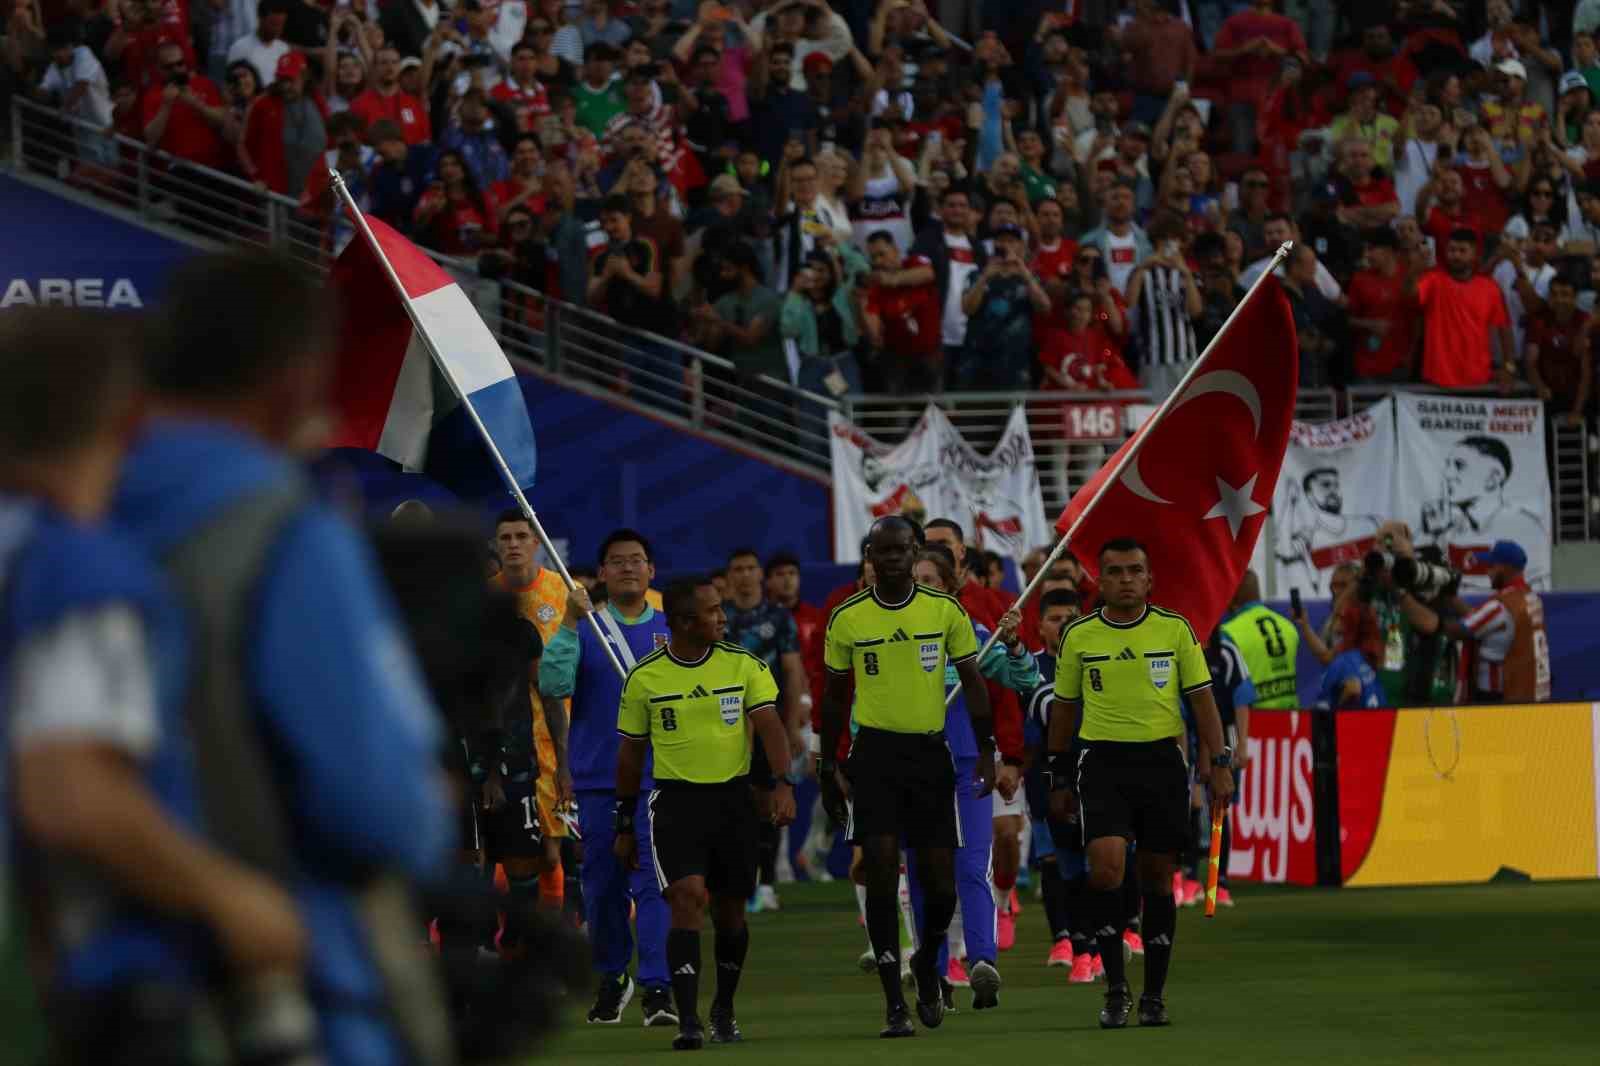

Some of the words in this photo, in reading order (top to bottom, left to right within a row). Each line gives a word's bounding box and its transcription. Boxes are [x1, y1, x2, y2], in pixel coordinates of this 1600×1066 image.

[0, 278, 144, 308] AREA
[1071, 406, 1116, 437] 146
[1152, 660, 1169, 668] FIFA
